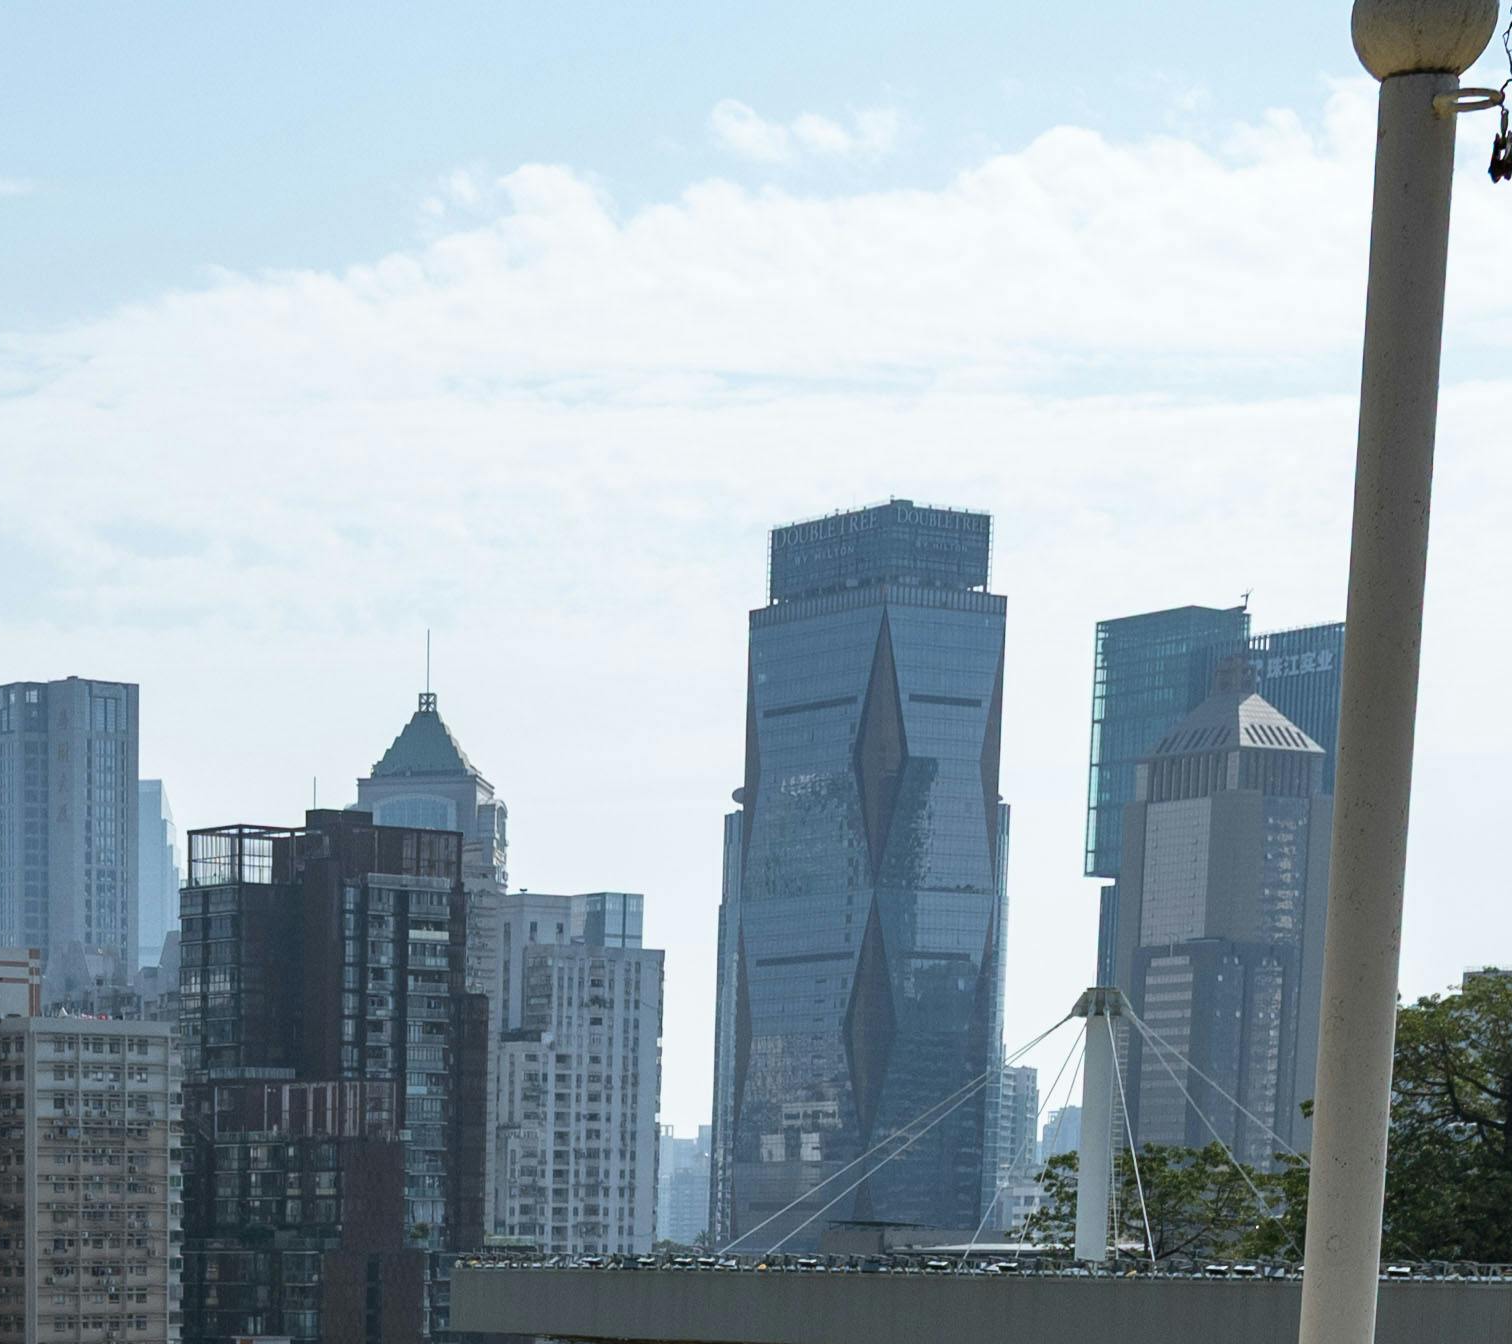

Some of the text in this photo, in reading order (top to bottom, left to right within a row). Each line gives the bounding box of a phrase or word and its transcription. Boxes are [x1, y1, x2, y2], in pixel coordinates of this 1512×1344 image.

[775, 511, 878, 550] DOUBLETREE
[1267, 650, 1334, 679] 珠江实业
